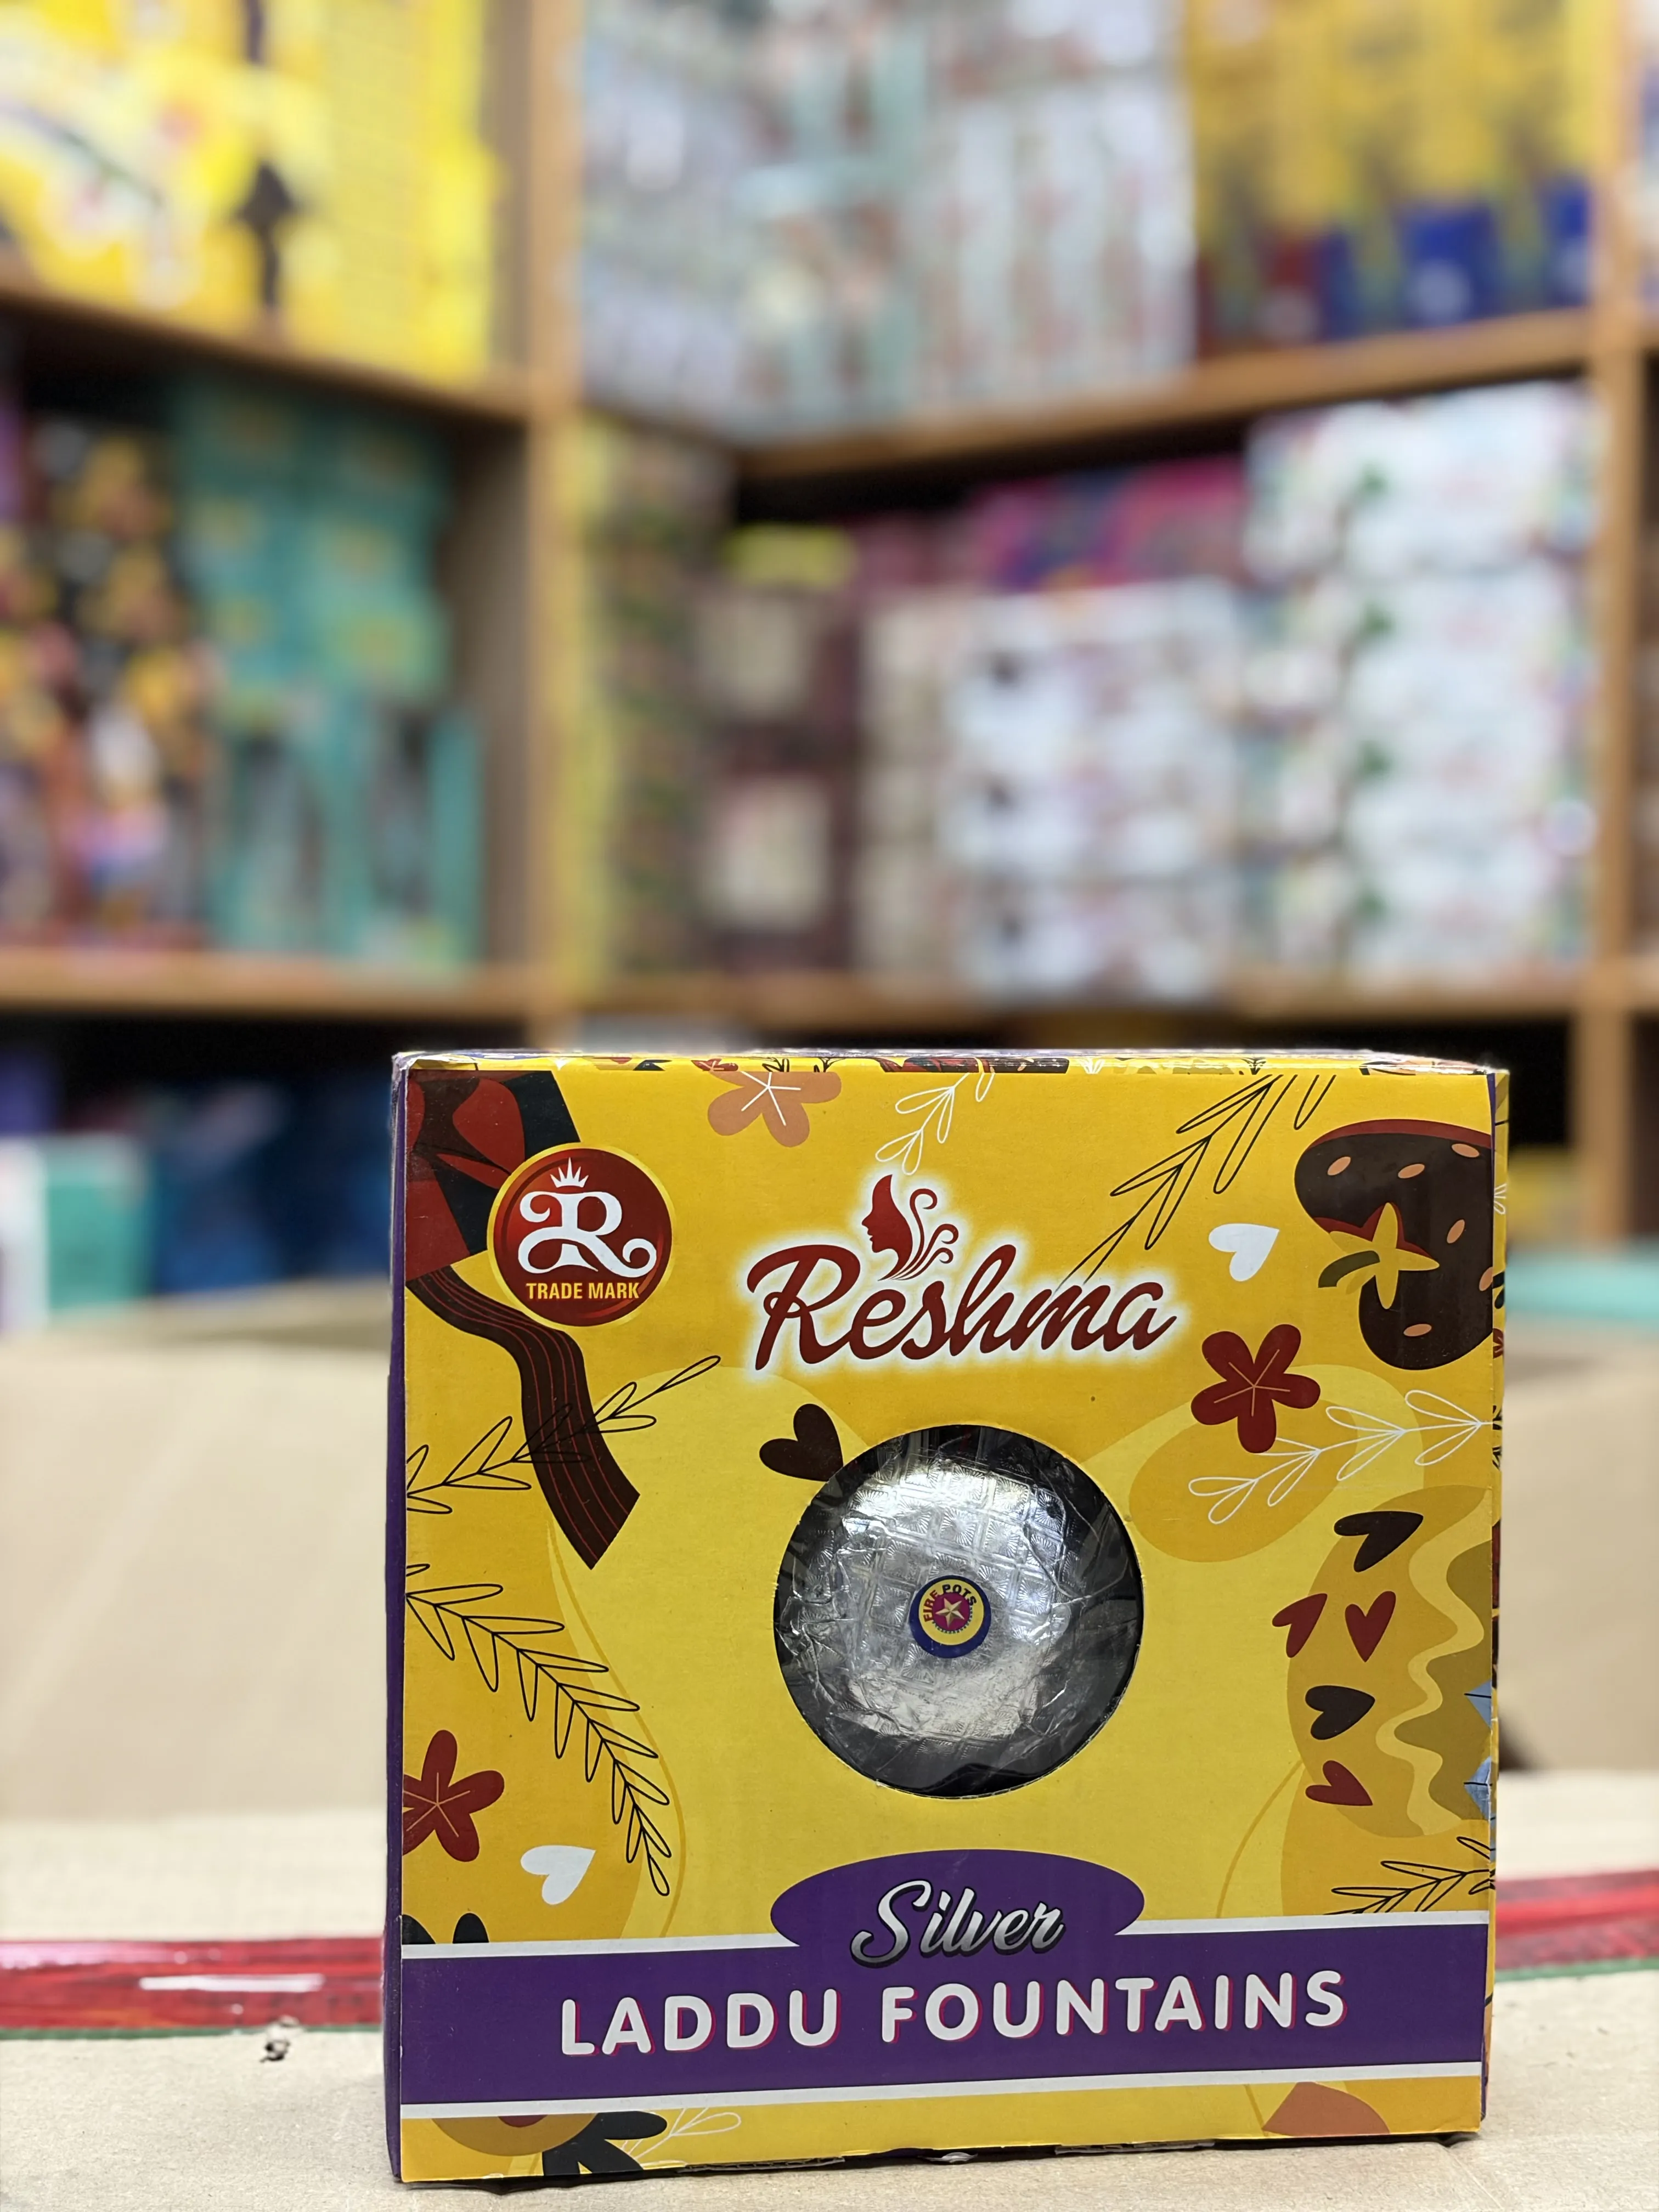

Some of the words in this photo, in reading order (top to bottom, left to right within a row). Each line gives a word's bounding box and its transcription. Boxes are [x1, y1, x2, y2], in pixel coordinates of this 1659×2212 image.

[518, 1191, 657, 1278] R
[526, 1283, 583, 1299] TRADE
[588, 1282, 640, 1299] MARK
[747, 1244, 1177, 1370] Reshma
[923, 1589, 939, 1622] FIRE
[942, 1584, 977, 1606] POTS
[850, 1880, 1065, 1968] Silver
[562, 1989, 841, 2056] LADDU
[882, 1970, 1348, 2042] FOUNTAINS
